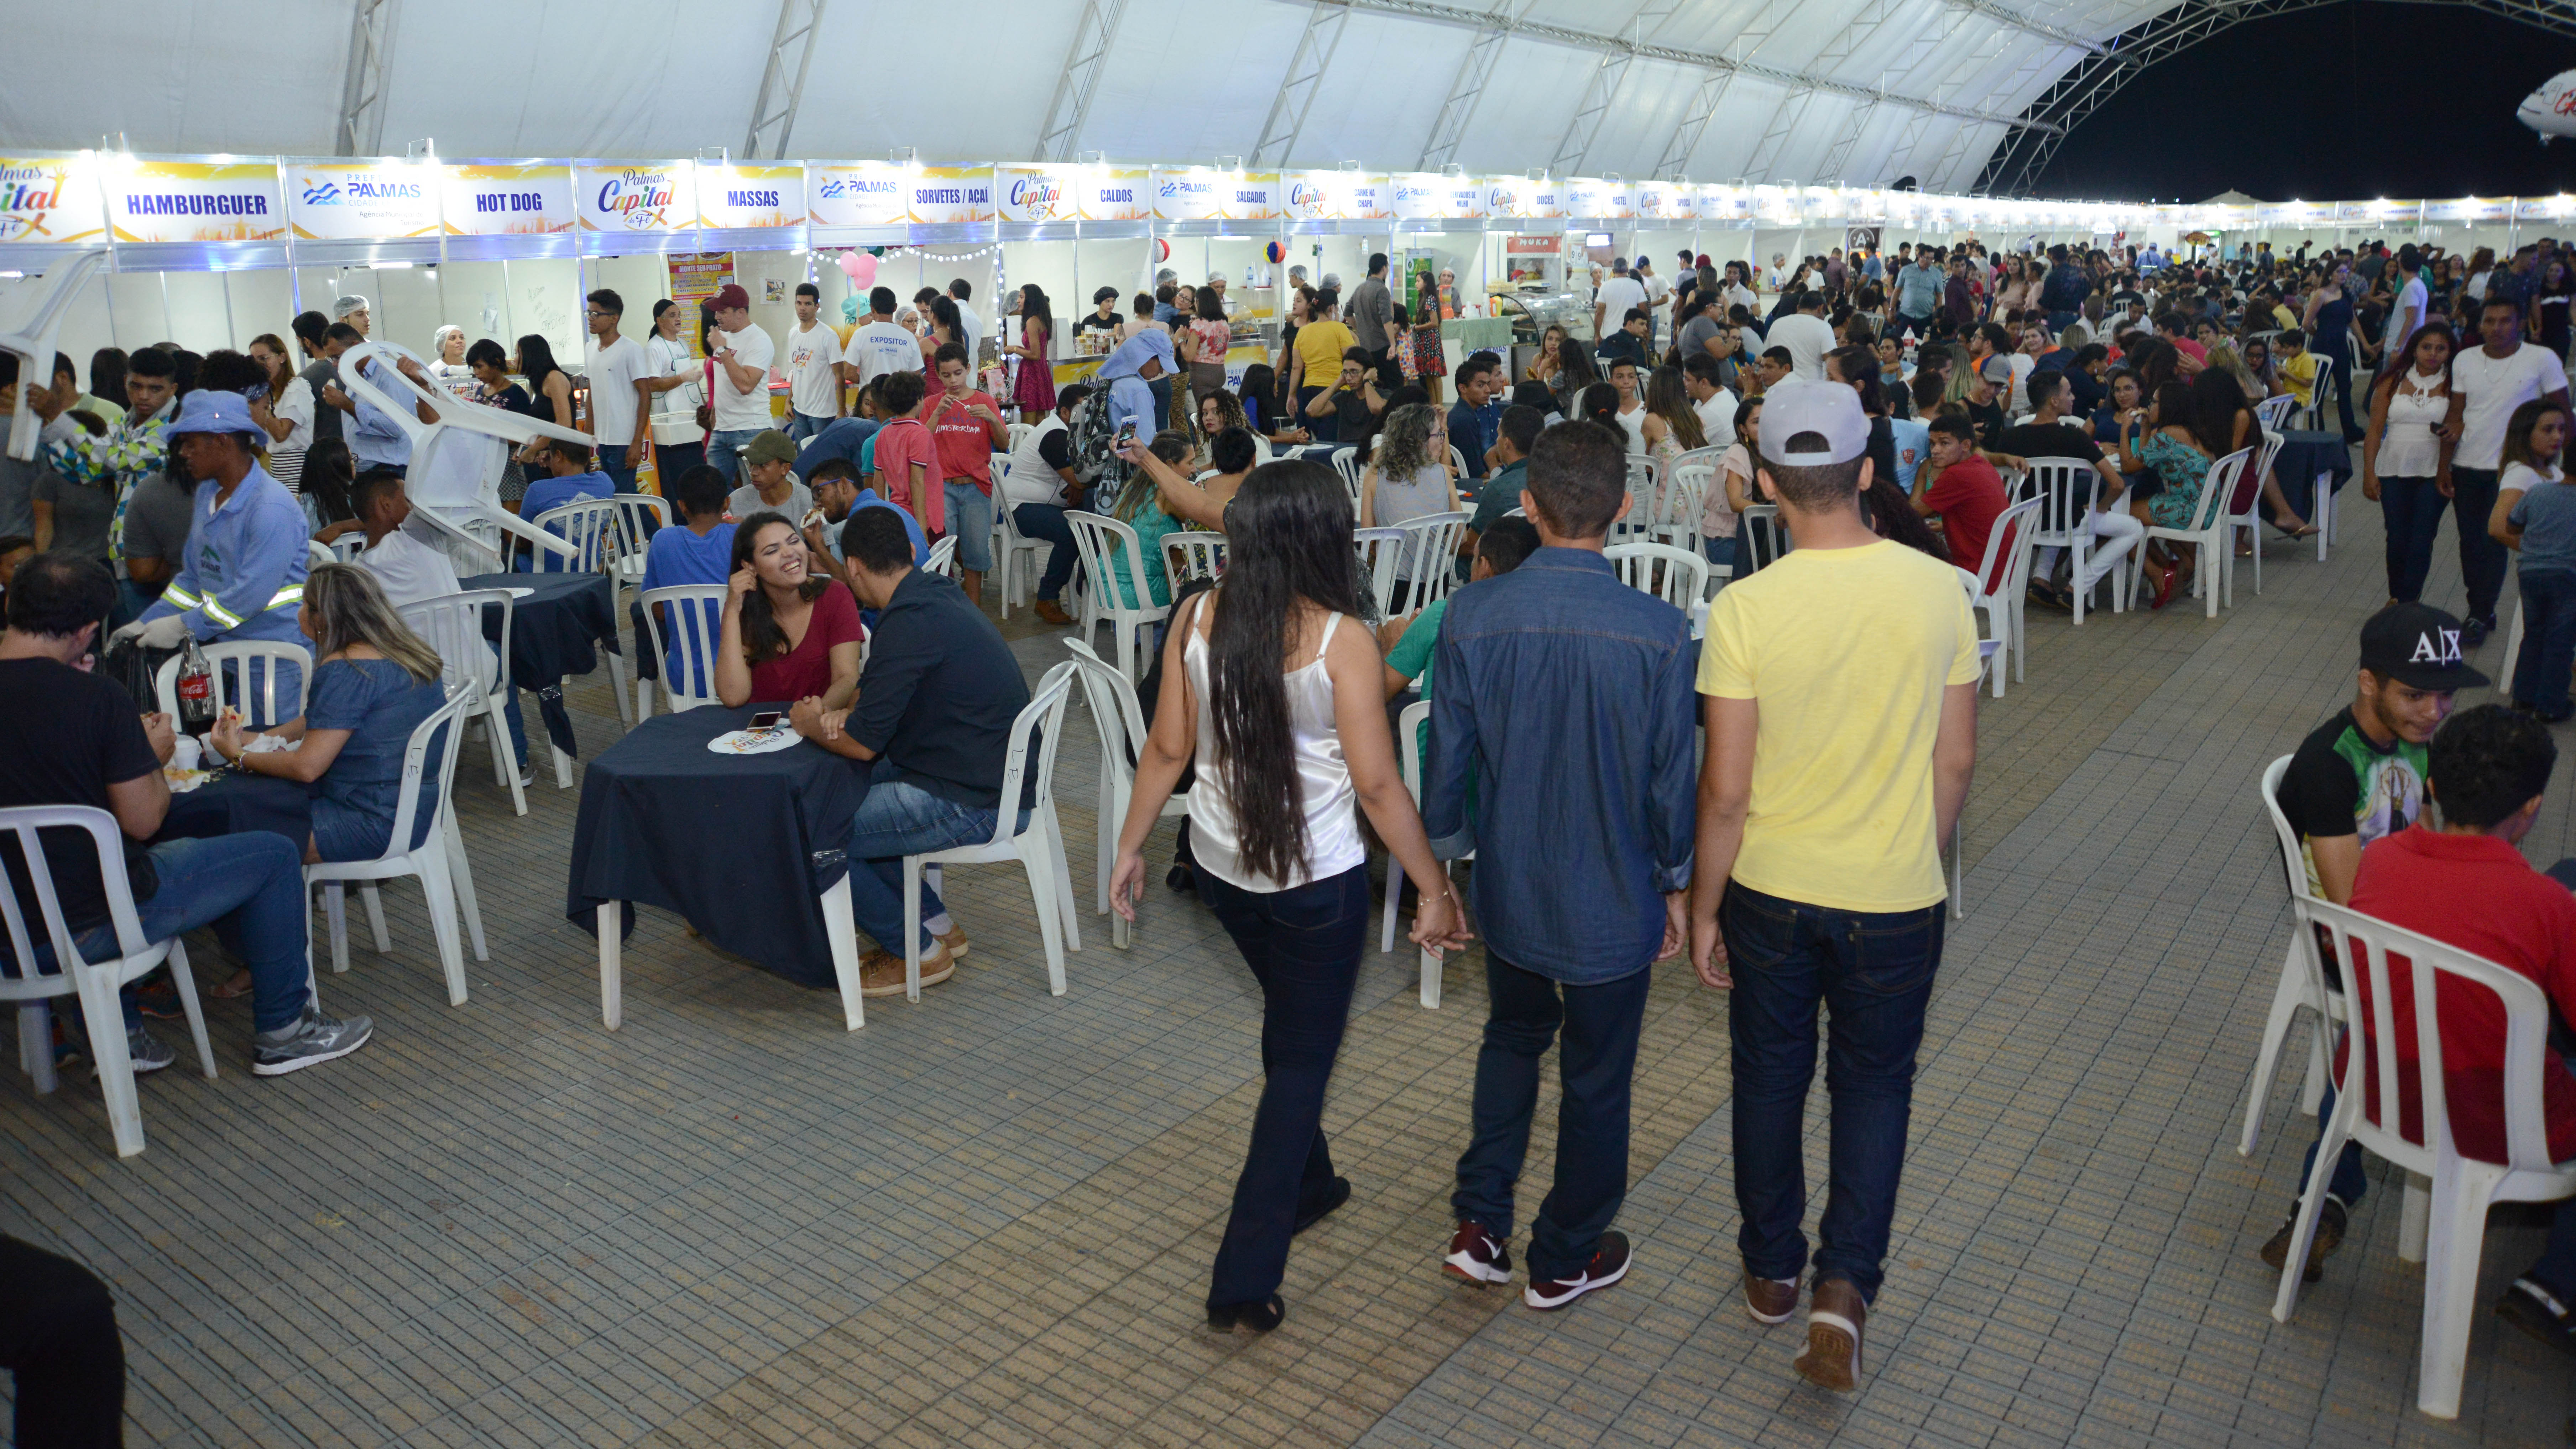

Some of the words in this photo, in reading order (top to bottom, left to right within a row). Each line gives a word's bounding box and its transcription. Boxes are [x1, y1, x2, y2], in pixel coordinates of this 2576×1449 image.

[0, 164, 43, 181] lmas
[623, 168, 665, 186] Palmas
[1028, 170, 1056, 185] Palmas
[0, 167, 70, 212] ital
[348, 183, 420, 198] PALMAS
[849, 181, 897, 193] PALMAS
[1010, 179, 1064, 208] Capital
[1180, 183, 1212, 193] PALMAS
[1354, 189, 1368, 197] CARNE
[1368, 189, 1375, 197] NA
[1410, 187, 1433, 197] PALMAS
[598, 180, 675, 215] Capital
[728, 191, 779, 207] MASSAS
[916, 189, 960, 204] SORVETES
[968, 186, 988, 205] AÇAÍ
[1101, 189, 1132, 202] CALDOS
[1236, 191, 1266, 203] SALGADOS
[1292, 183, 1329, 207] Capital
[1537, 195, 1554, 205] DOCES
[1613, 197, 1626, 205] PASTEL
[127, 195, 267, 215] HAMBURGUER
[476, 194, 506, 212] HOT
[511, 193, 542, 211] DOG
[1676, 198, 1690, 207] TAPIOCA
[1855, 232, 1866, 246] A
[1572, 250, 1575, 258] 9
[1578, 252, 1581, 260] 9
[870, 336, 907, 346] EXPOSITOR
[1227, 375, 1242, 387] PAL
[935, 424, 980, 434] AMSTERDAM
